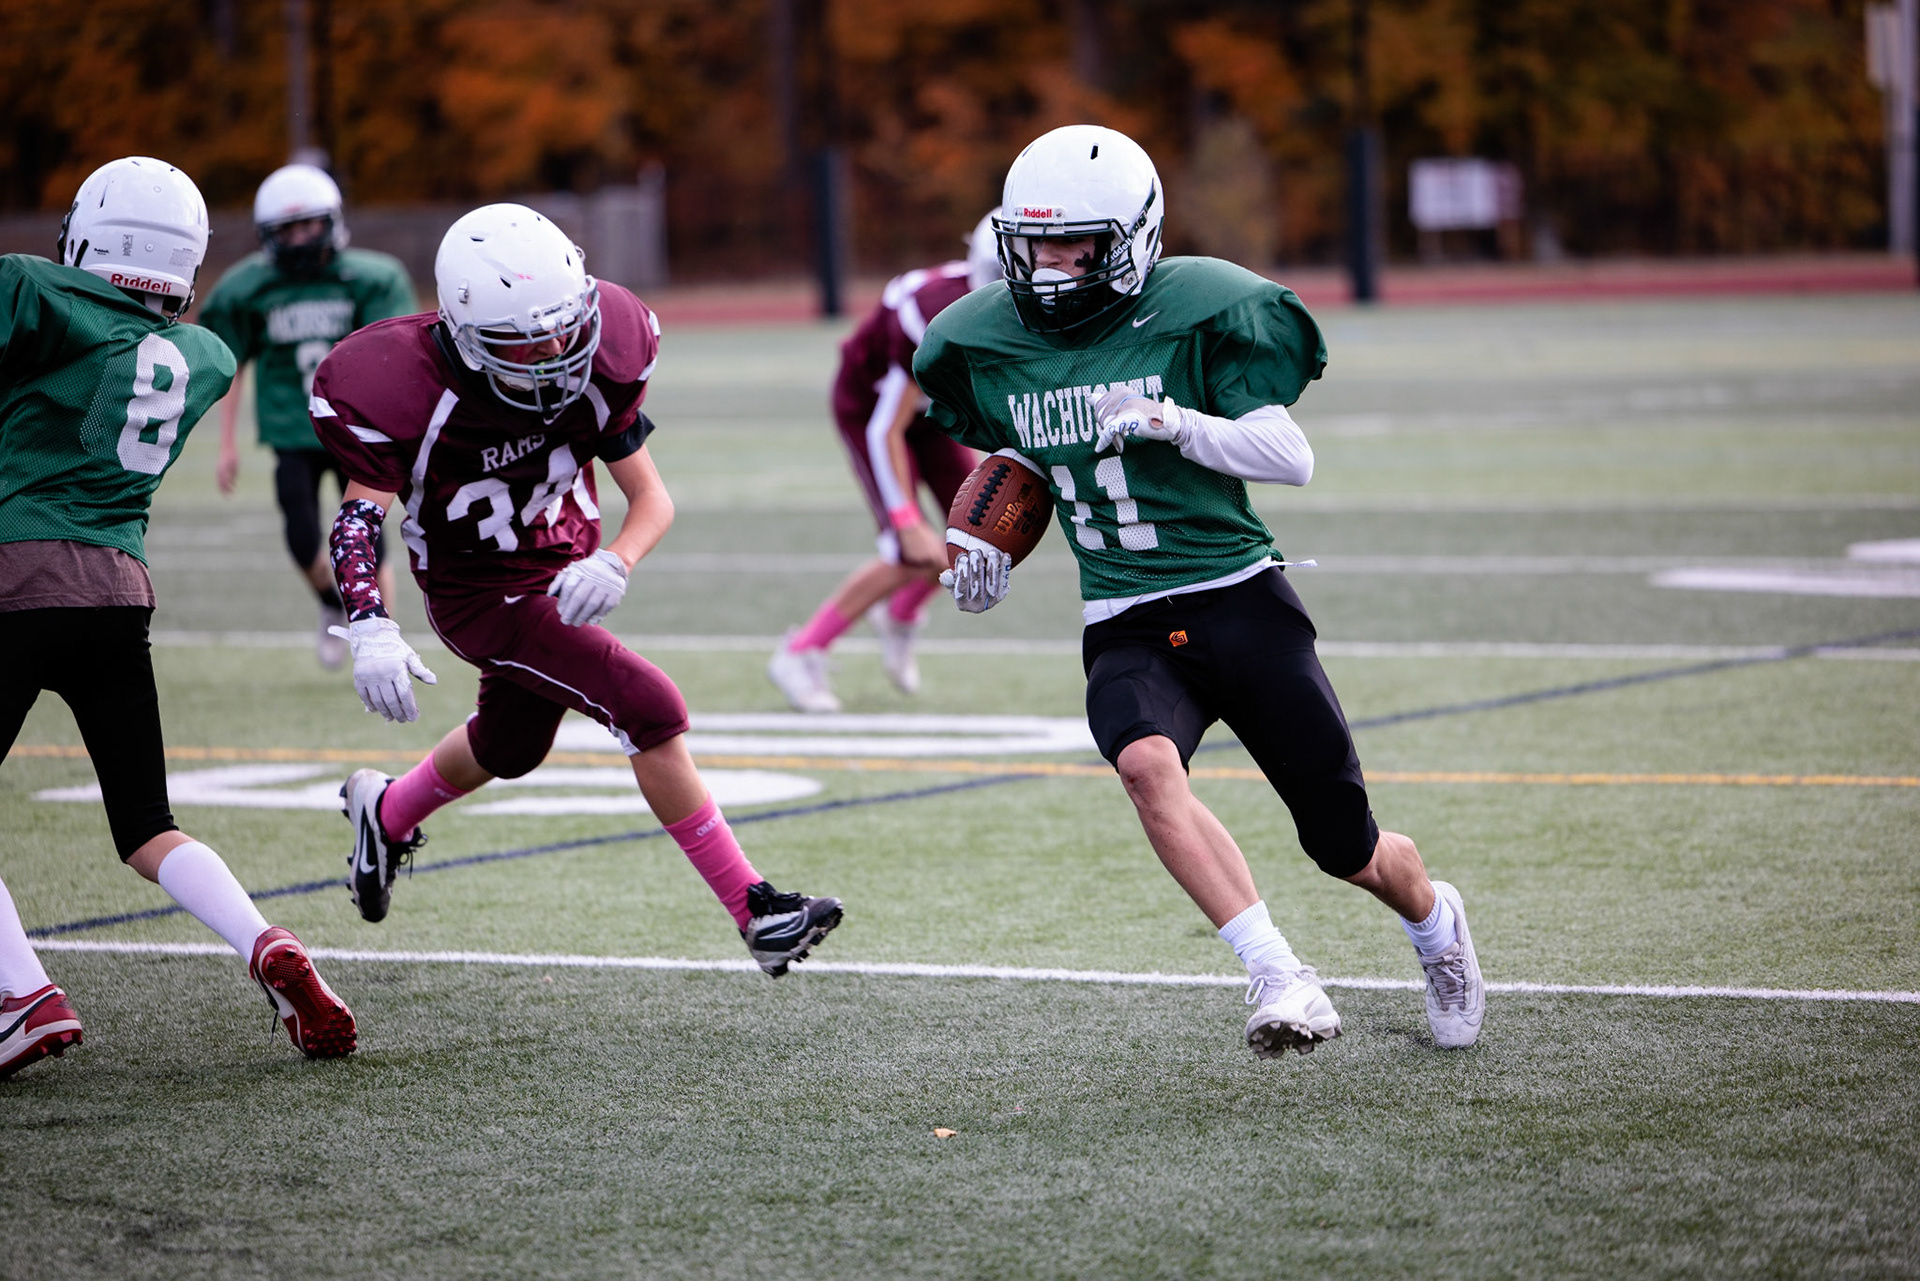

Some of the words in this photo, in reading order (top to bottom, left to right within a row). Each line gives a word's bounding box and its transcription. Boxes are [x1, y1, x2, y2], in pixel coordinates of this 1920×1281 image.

[1024, 208, 1052, 218] Riddell
[111, 273, 172, 294] Riddell
[116, 332, 190, 475] 8
[480, 433, 546, 472] RAMS
[446, 442, 578, 552] 34
[1051, 455, 1160, 551] 11
